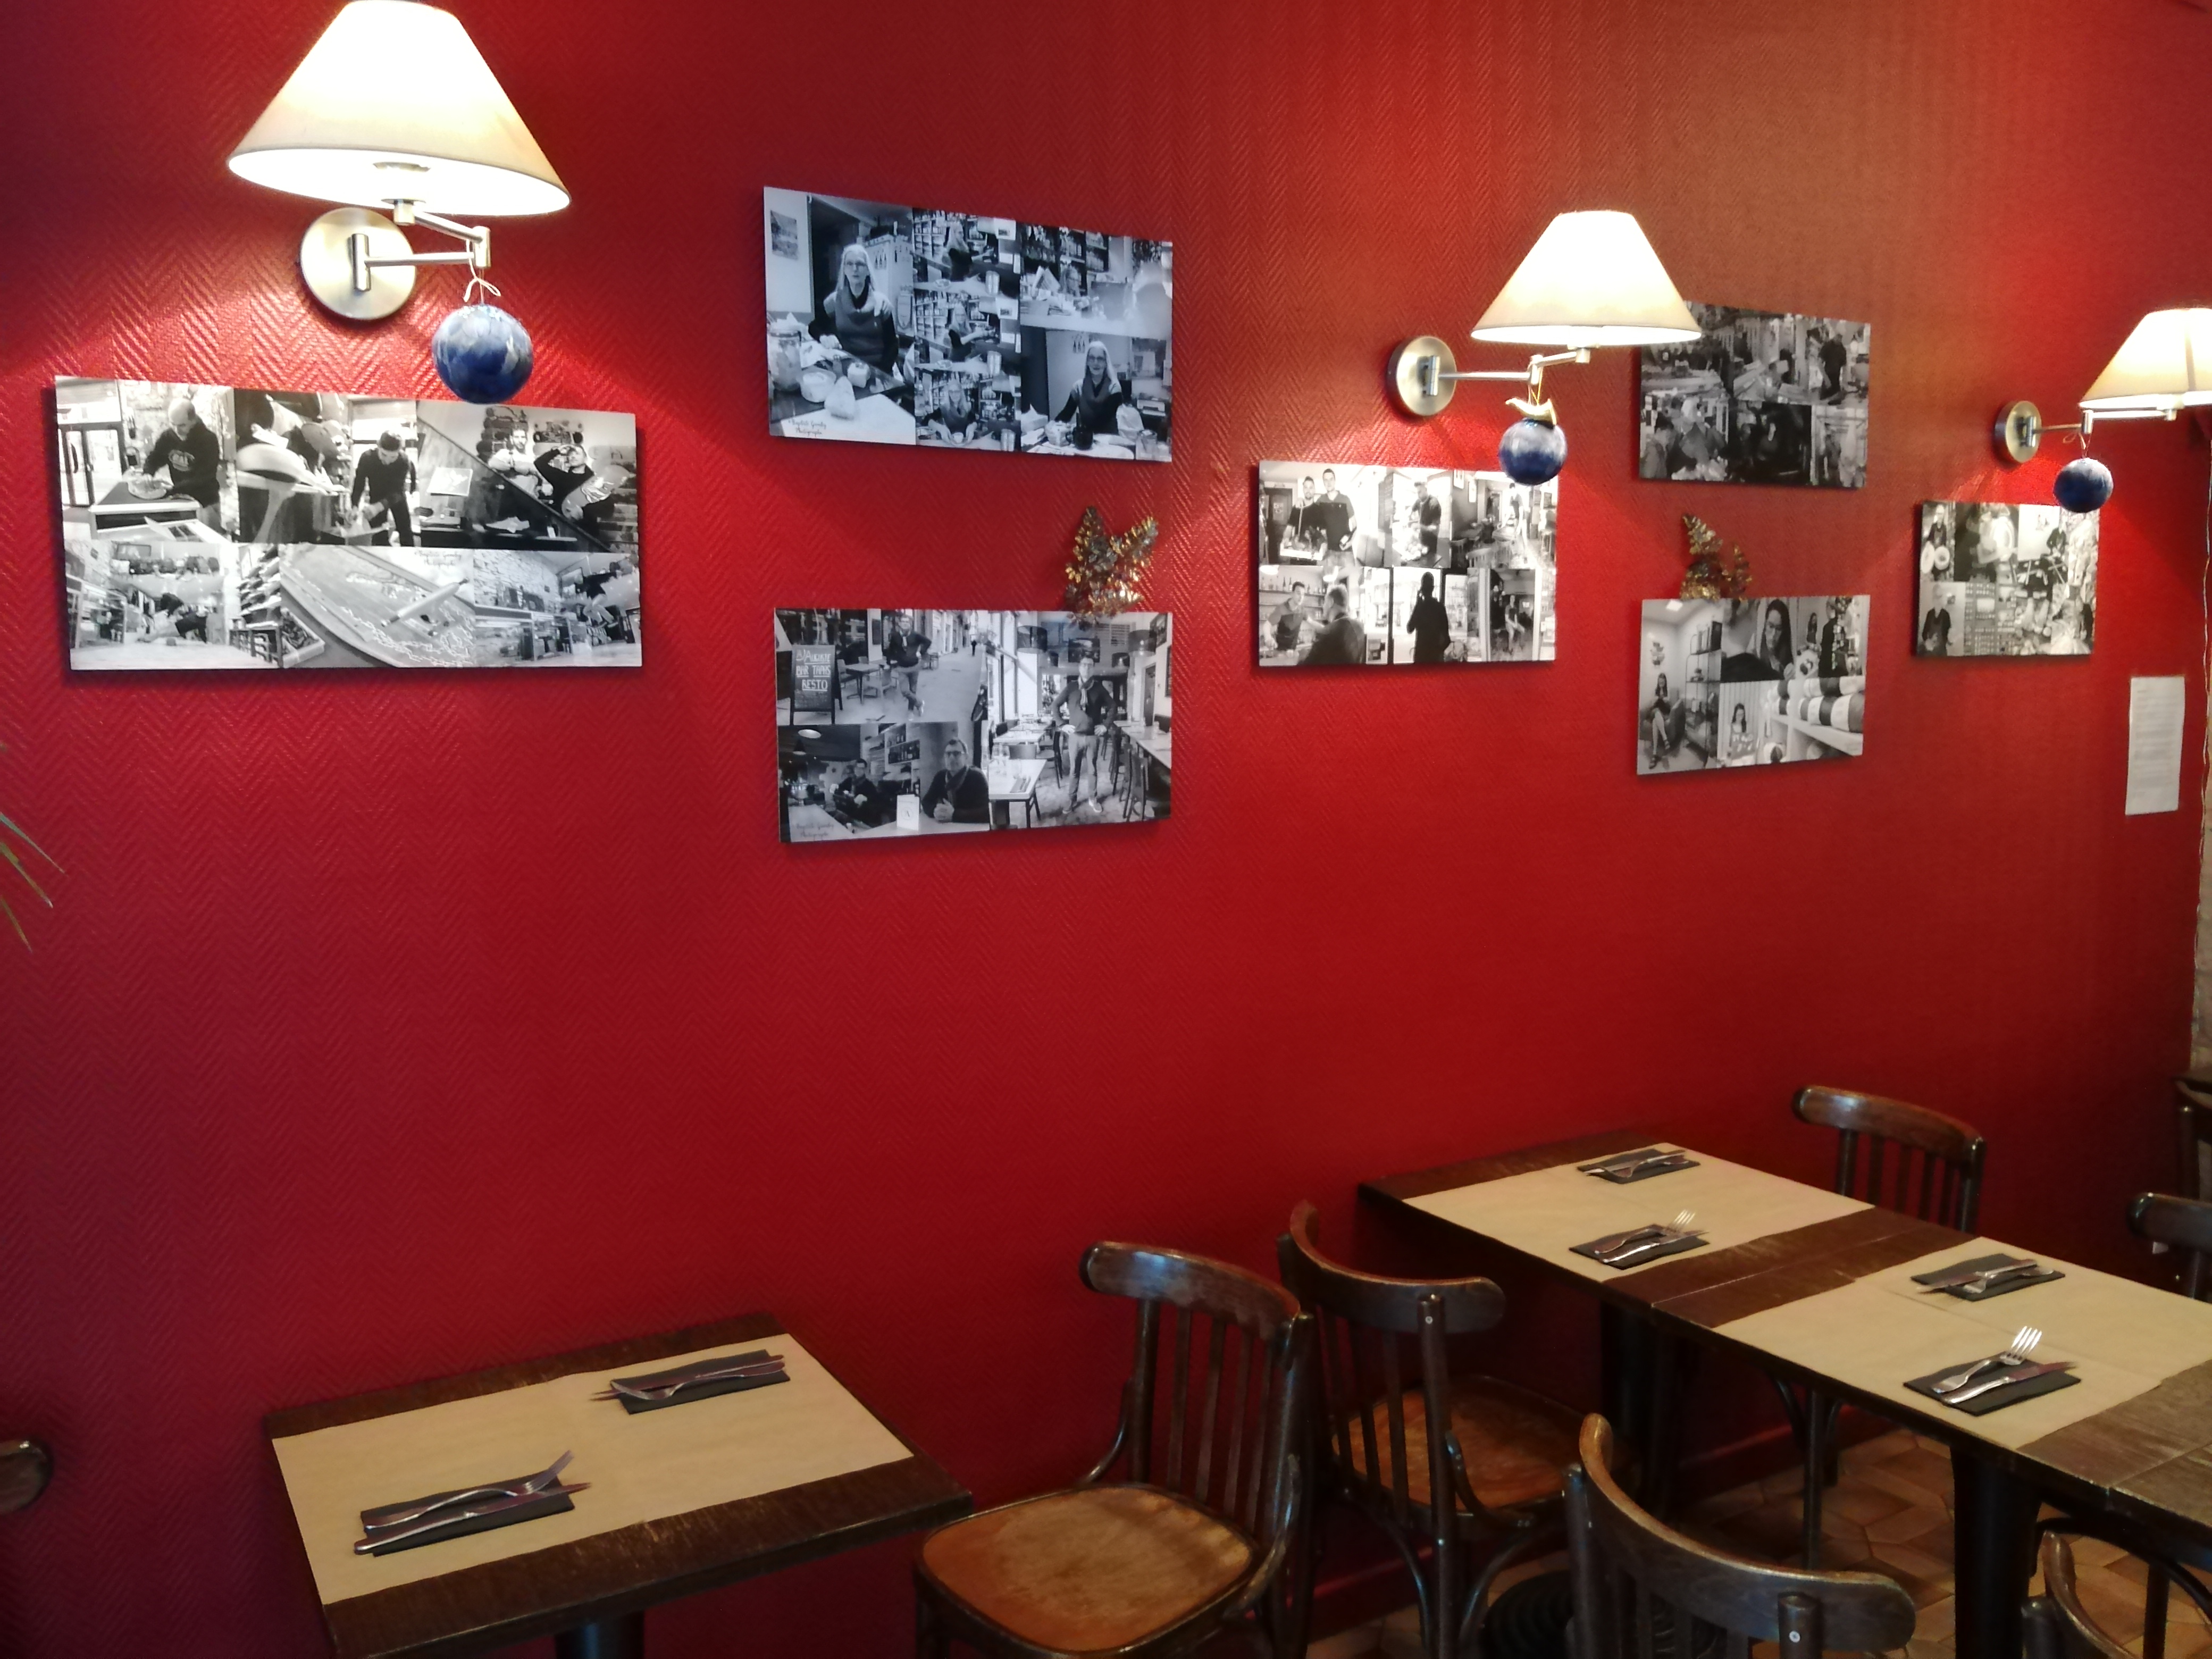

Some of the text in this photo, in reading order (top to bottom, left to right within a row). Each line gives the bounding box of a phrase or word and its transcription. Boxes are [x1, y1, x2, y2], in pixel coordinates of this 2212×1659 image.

[796, 665, 831, 676] BAR TAPAS
[802, 679, 828, 690] RESTO
